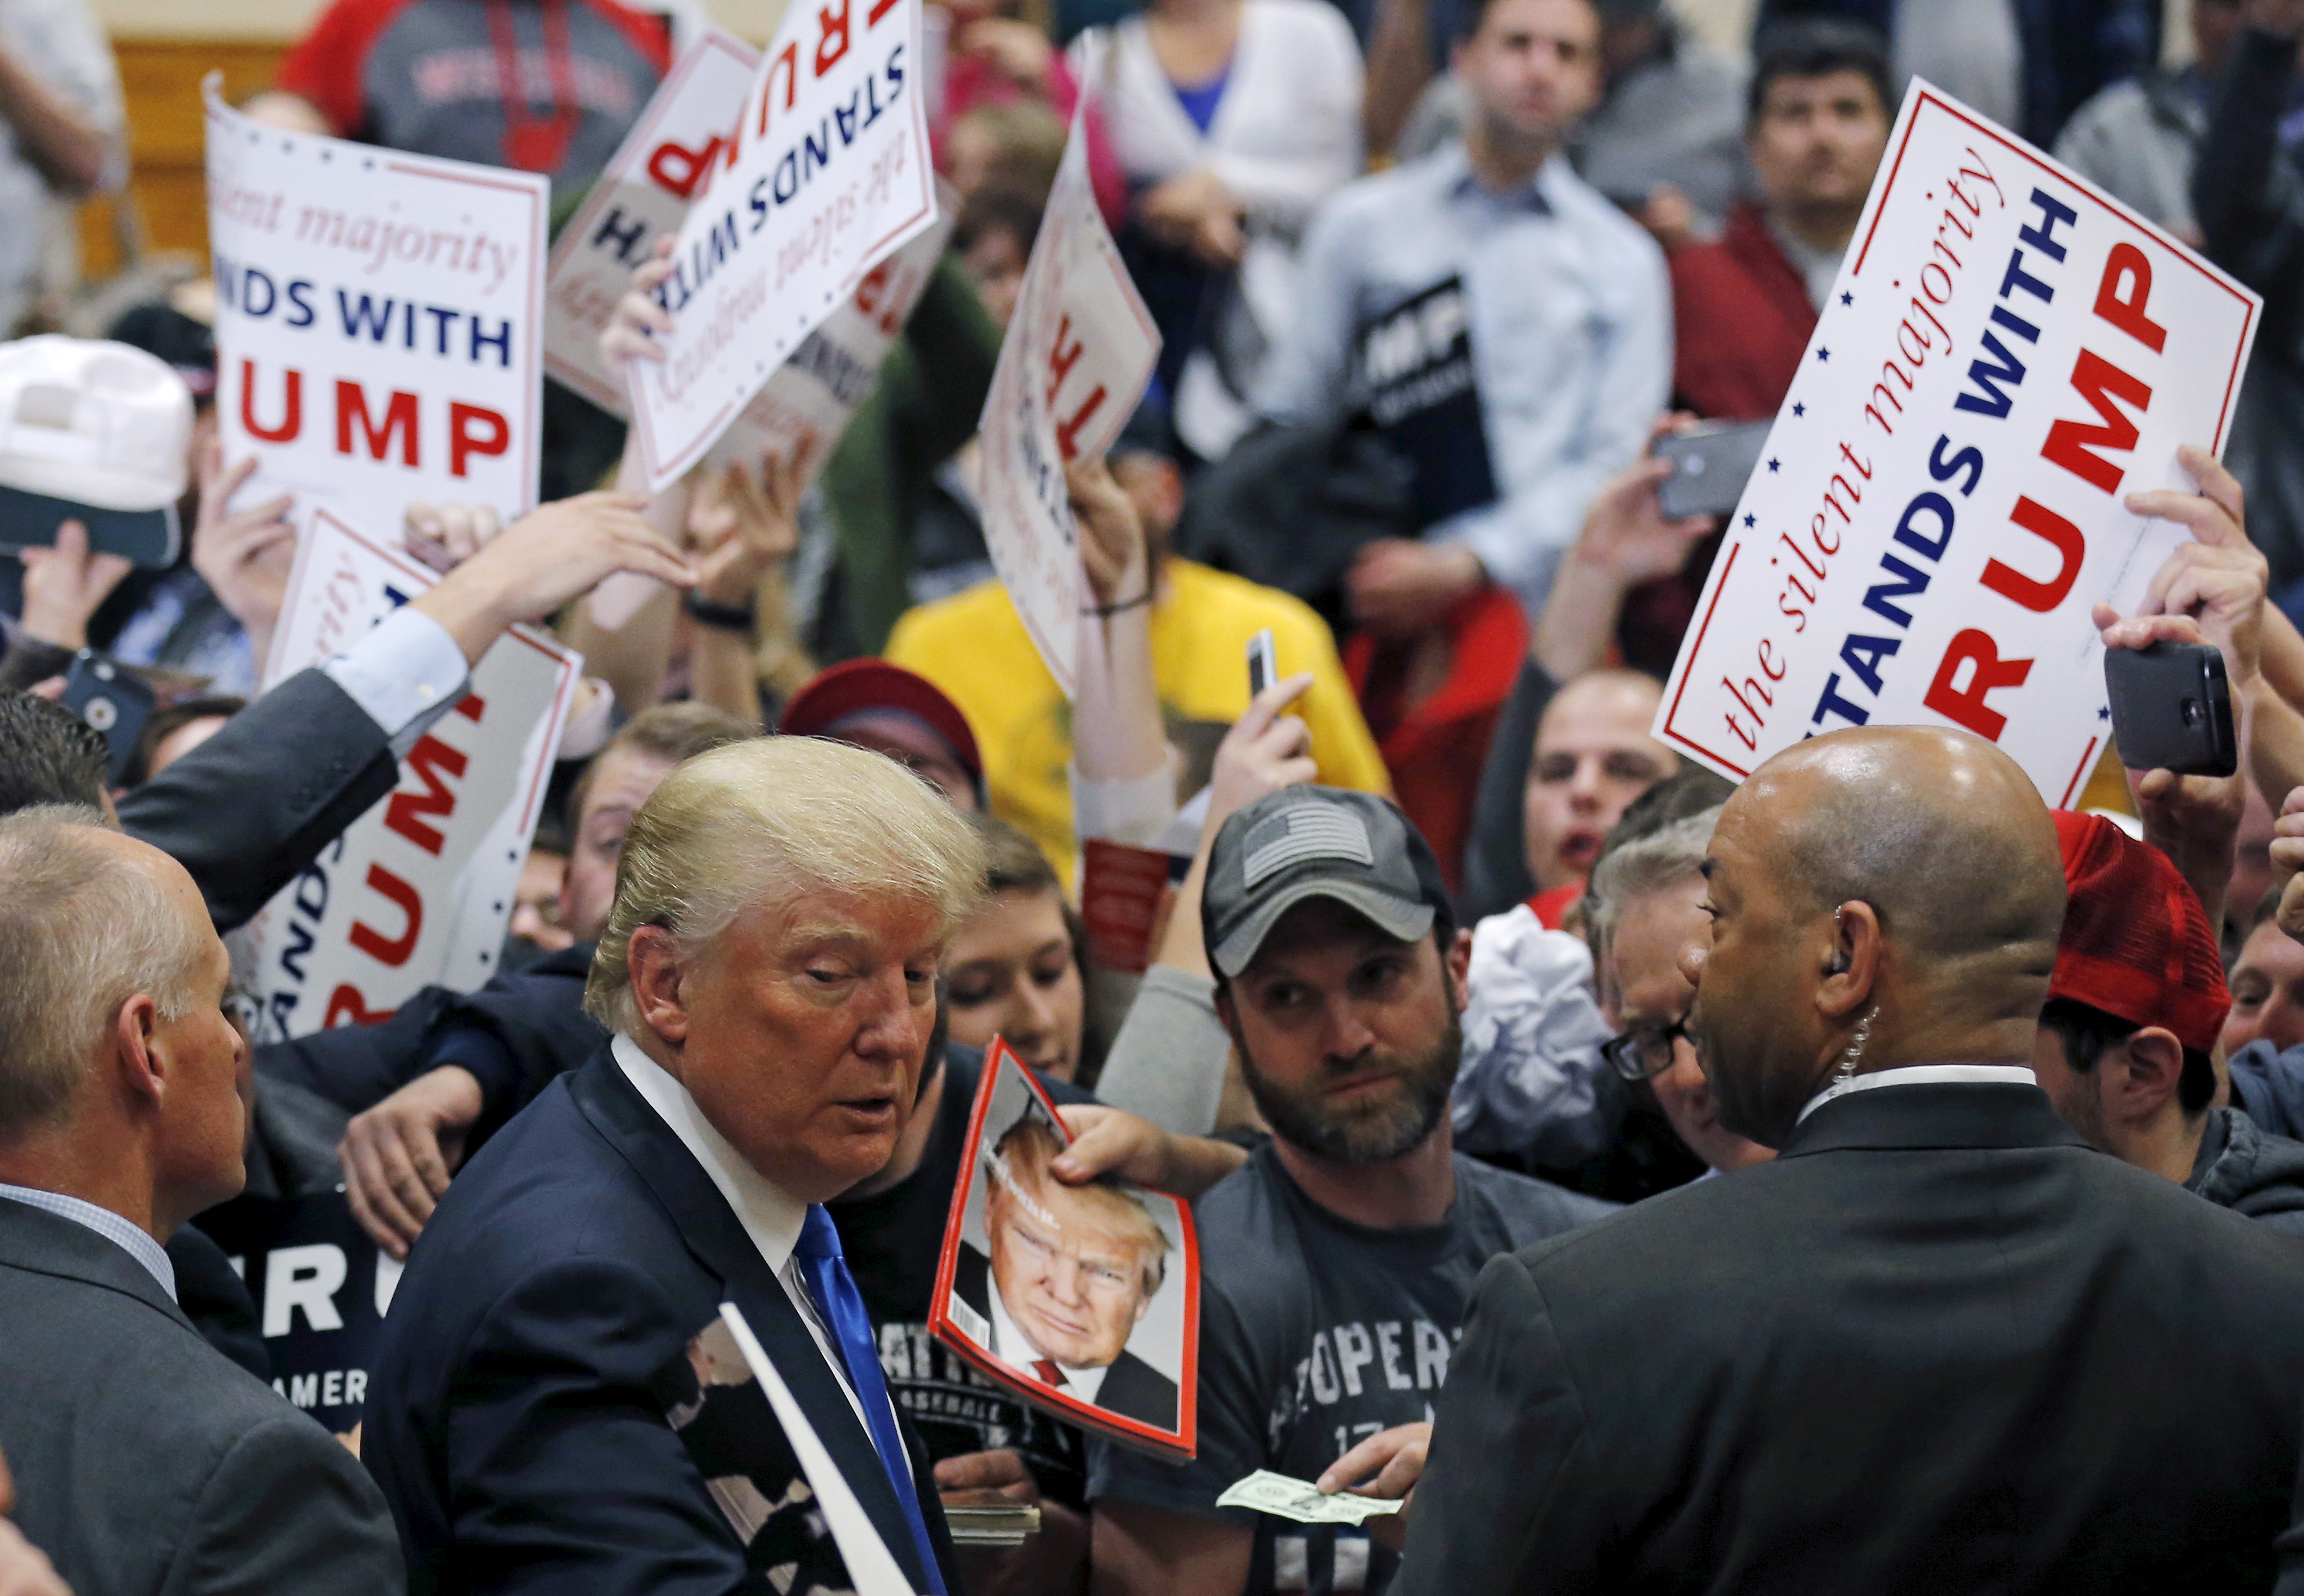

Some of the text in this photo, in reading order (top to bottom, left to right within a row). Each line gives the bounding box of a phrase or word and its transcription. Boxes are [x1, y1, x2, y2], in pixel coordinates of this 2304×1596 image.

[750, 44, 905, 234] STANDS
[295, 200, 518, 295] majority
[336, 287, 512, 369] WITH
[240, 358, 510, 478] UMP
[1722, 146, 2006, 752] the silent majority
[1805, 187, 2079, 743] TANDS WITH
[1923, 242, 2167, 743] RUMP
[901, 1390, 1001, 1423] ASEBALL
